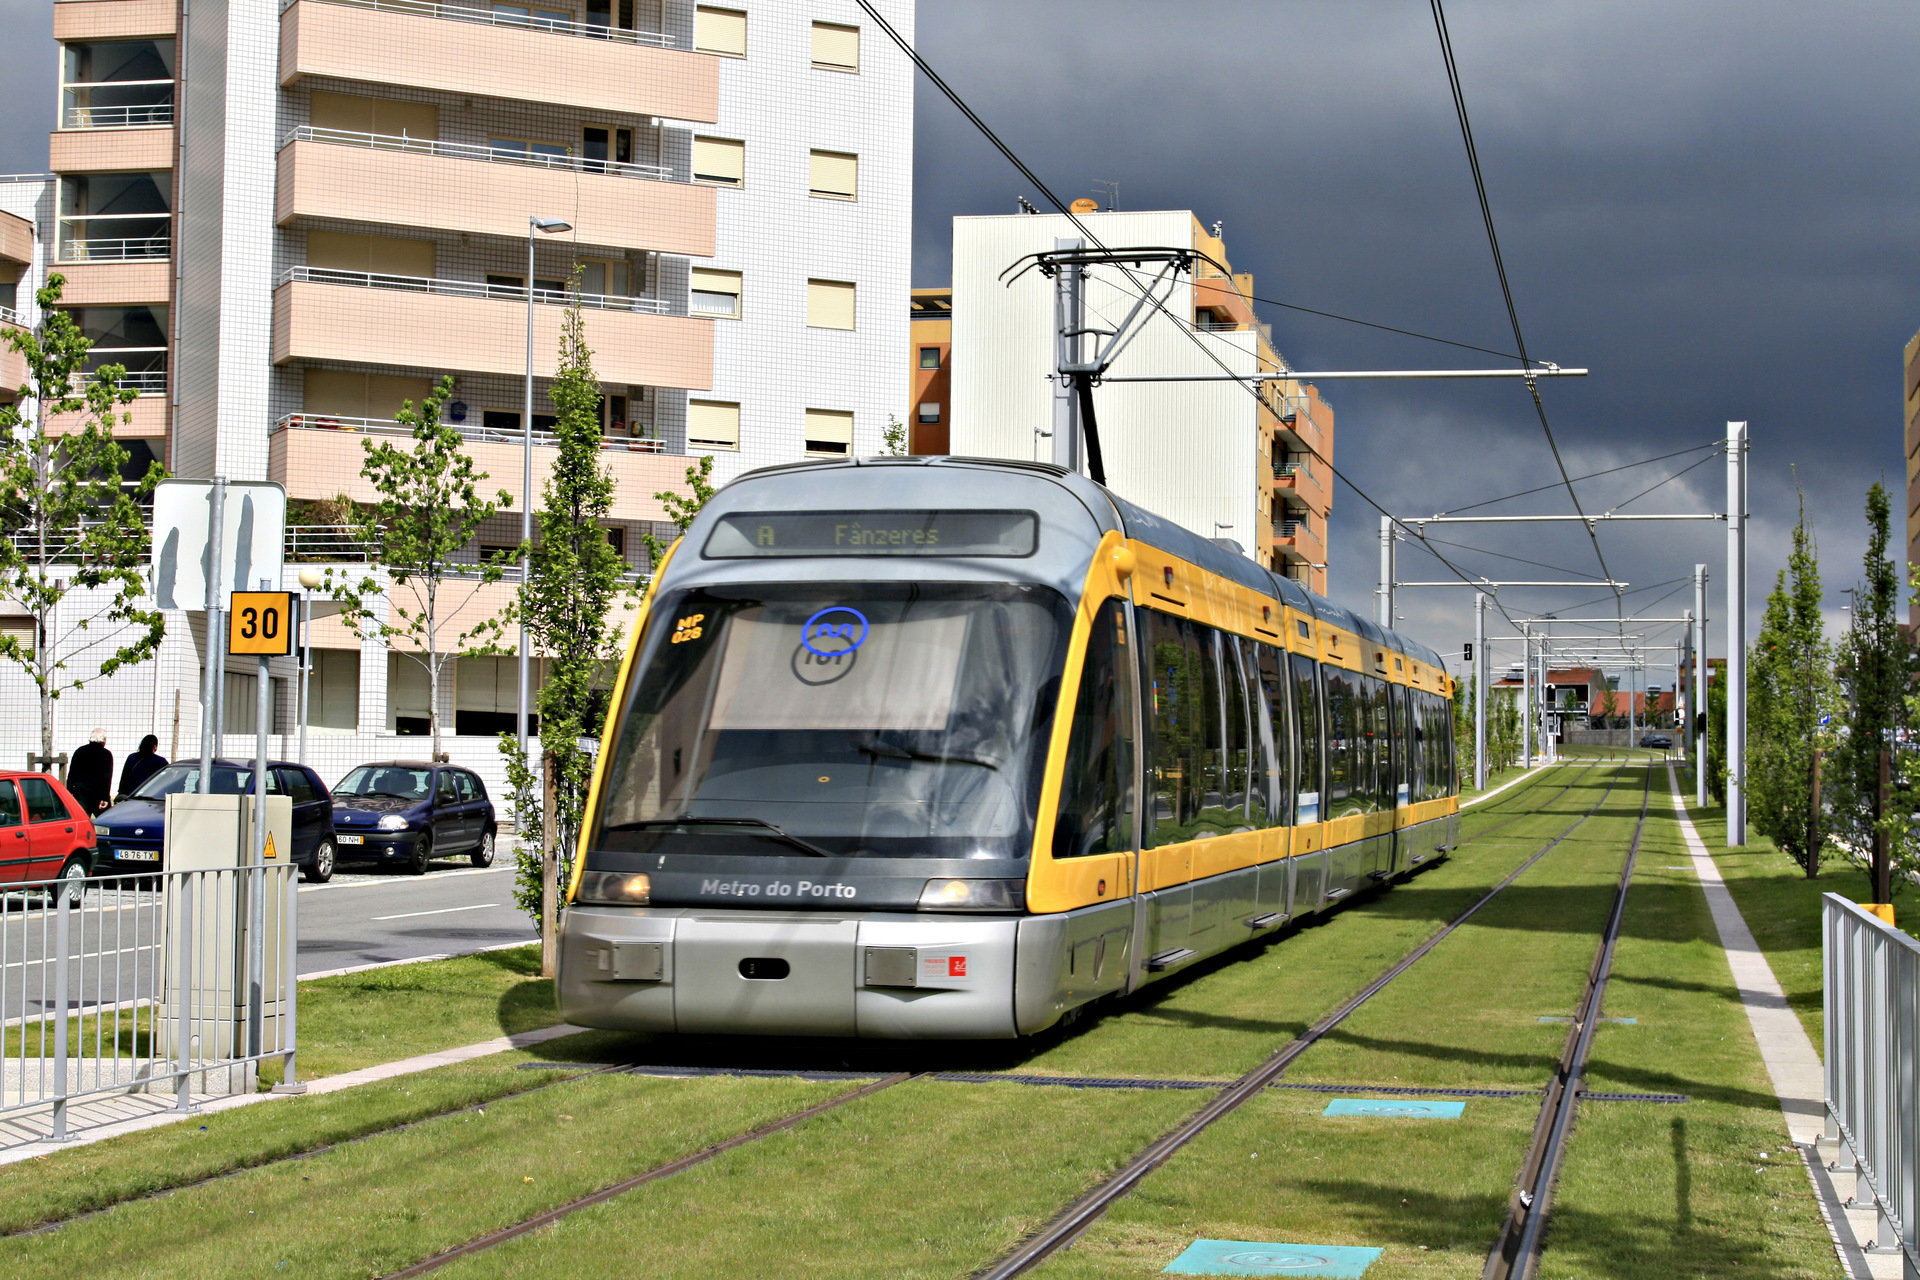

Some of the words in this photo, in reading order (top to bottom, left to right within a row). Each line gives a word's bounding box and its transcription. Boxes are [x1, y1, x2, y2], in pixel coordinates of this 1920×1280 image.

[757, 525, 775, 546] A
[835, 522, 939, 546] Fânzeres
[241, 607, 279, 639] 30
[671, 627, 703, 644] 028
[700, 879, 761, 896] Metro
[765, 881, 792, 896] do
[796, 881, 857, 899] Porto
